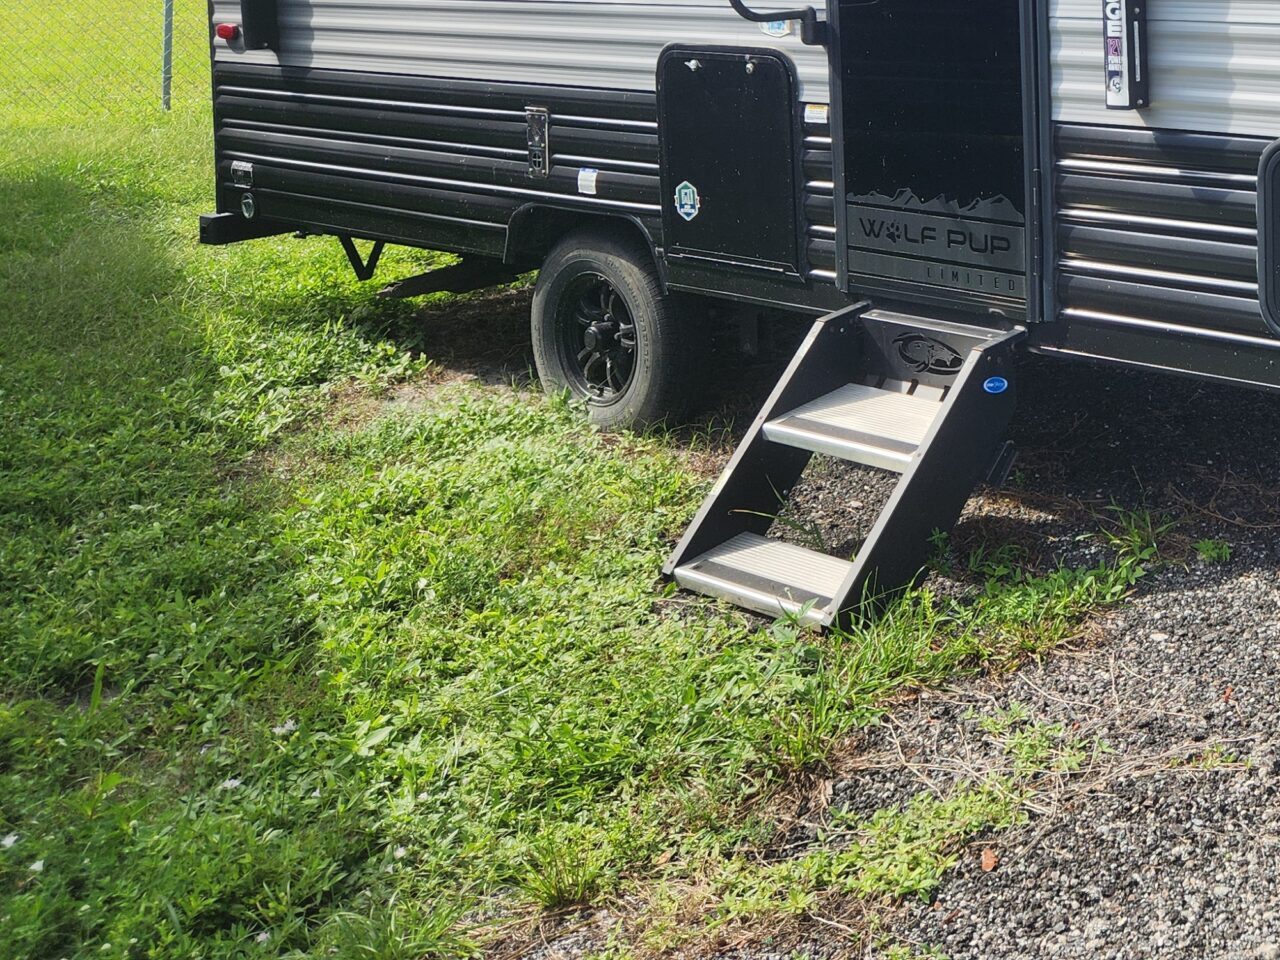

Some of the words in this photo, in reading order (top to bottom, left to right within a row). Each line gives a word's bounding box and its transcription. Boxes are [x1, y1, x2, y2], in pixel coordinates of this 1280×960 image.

[859, 217, 937, 244] WLF
[947, 229, 1011, 255] PUP
[927, 267, 1015, 291] LIMITED
